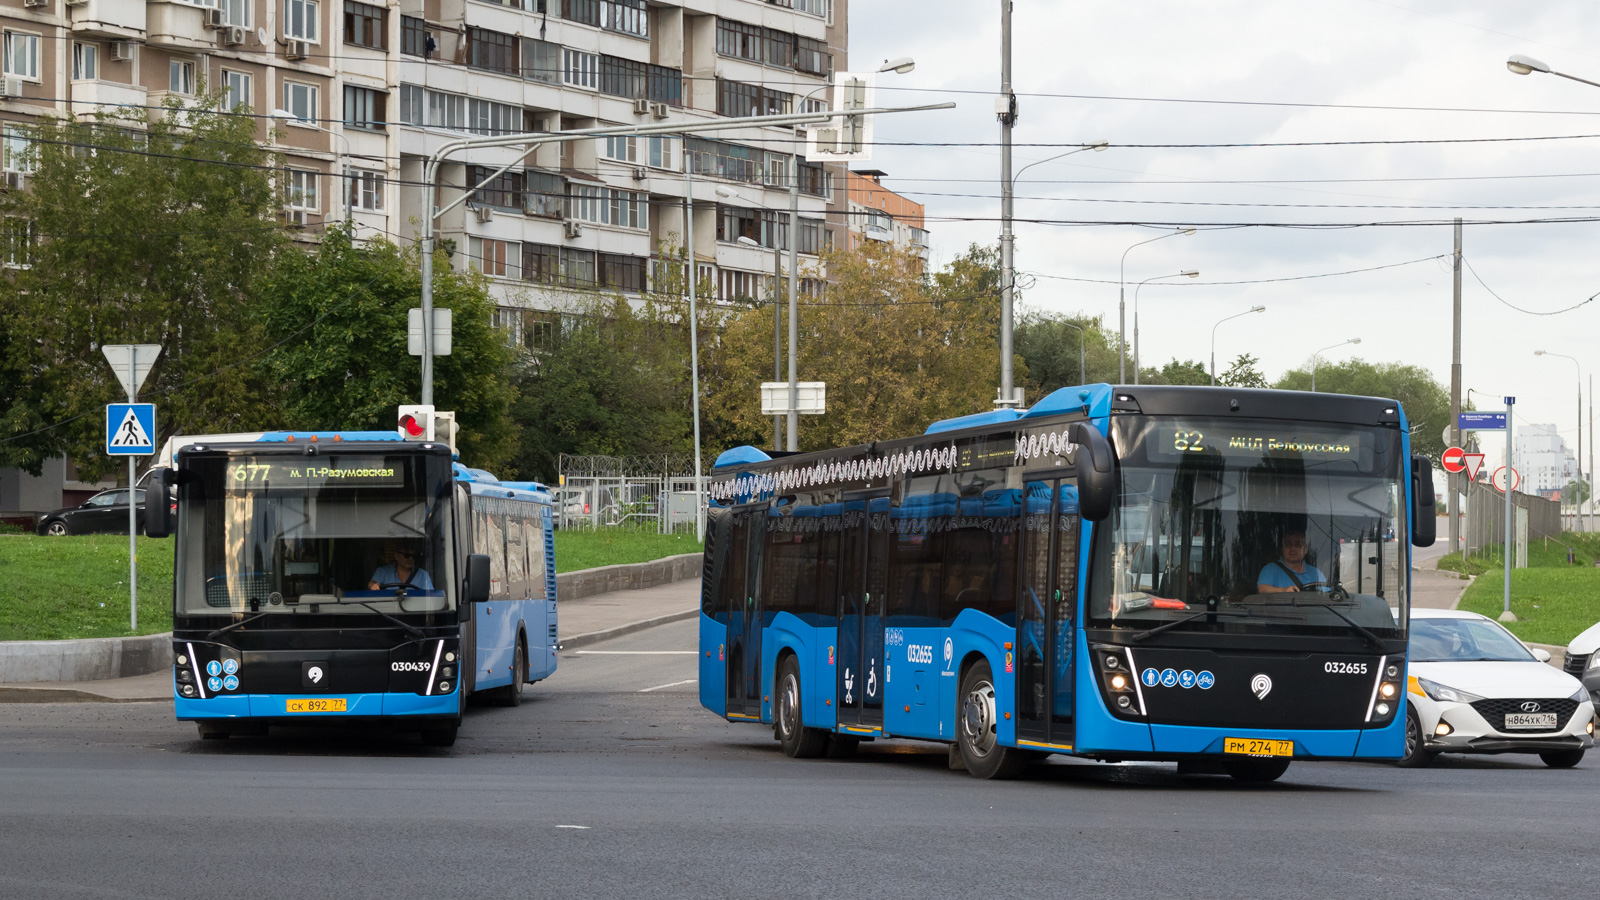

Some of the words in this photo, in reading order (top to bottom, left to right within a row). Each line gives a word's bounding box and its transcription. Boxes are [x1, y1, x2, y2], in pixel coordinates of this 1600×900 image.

[1174, 430, 1204, 452] 82
[1229, 437, 1263, 451] МЦД
[1268, 438, 1350, 453] Белорусская
[234, 464, 271, 482] 677
[290, 469, 302, 478] м.
[306, 467, 394, 478] П.-Разумовская
[907, 644, 933, 664] 032655
[391, 662, 431, 672] 030439
[1324, 661, 1368, 674] 032655
[308, 701, 327, 711] 892
[333, 700, 343, 708] 77
[1542, 714, 1556, 722] 716
[1230, 742, 1245, 752] РМ
[1249, 741, 1271, 753] 274
[1278, 741, 1290, 751] 77
